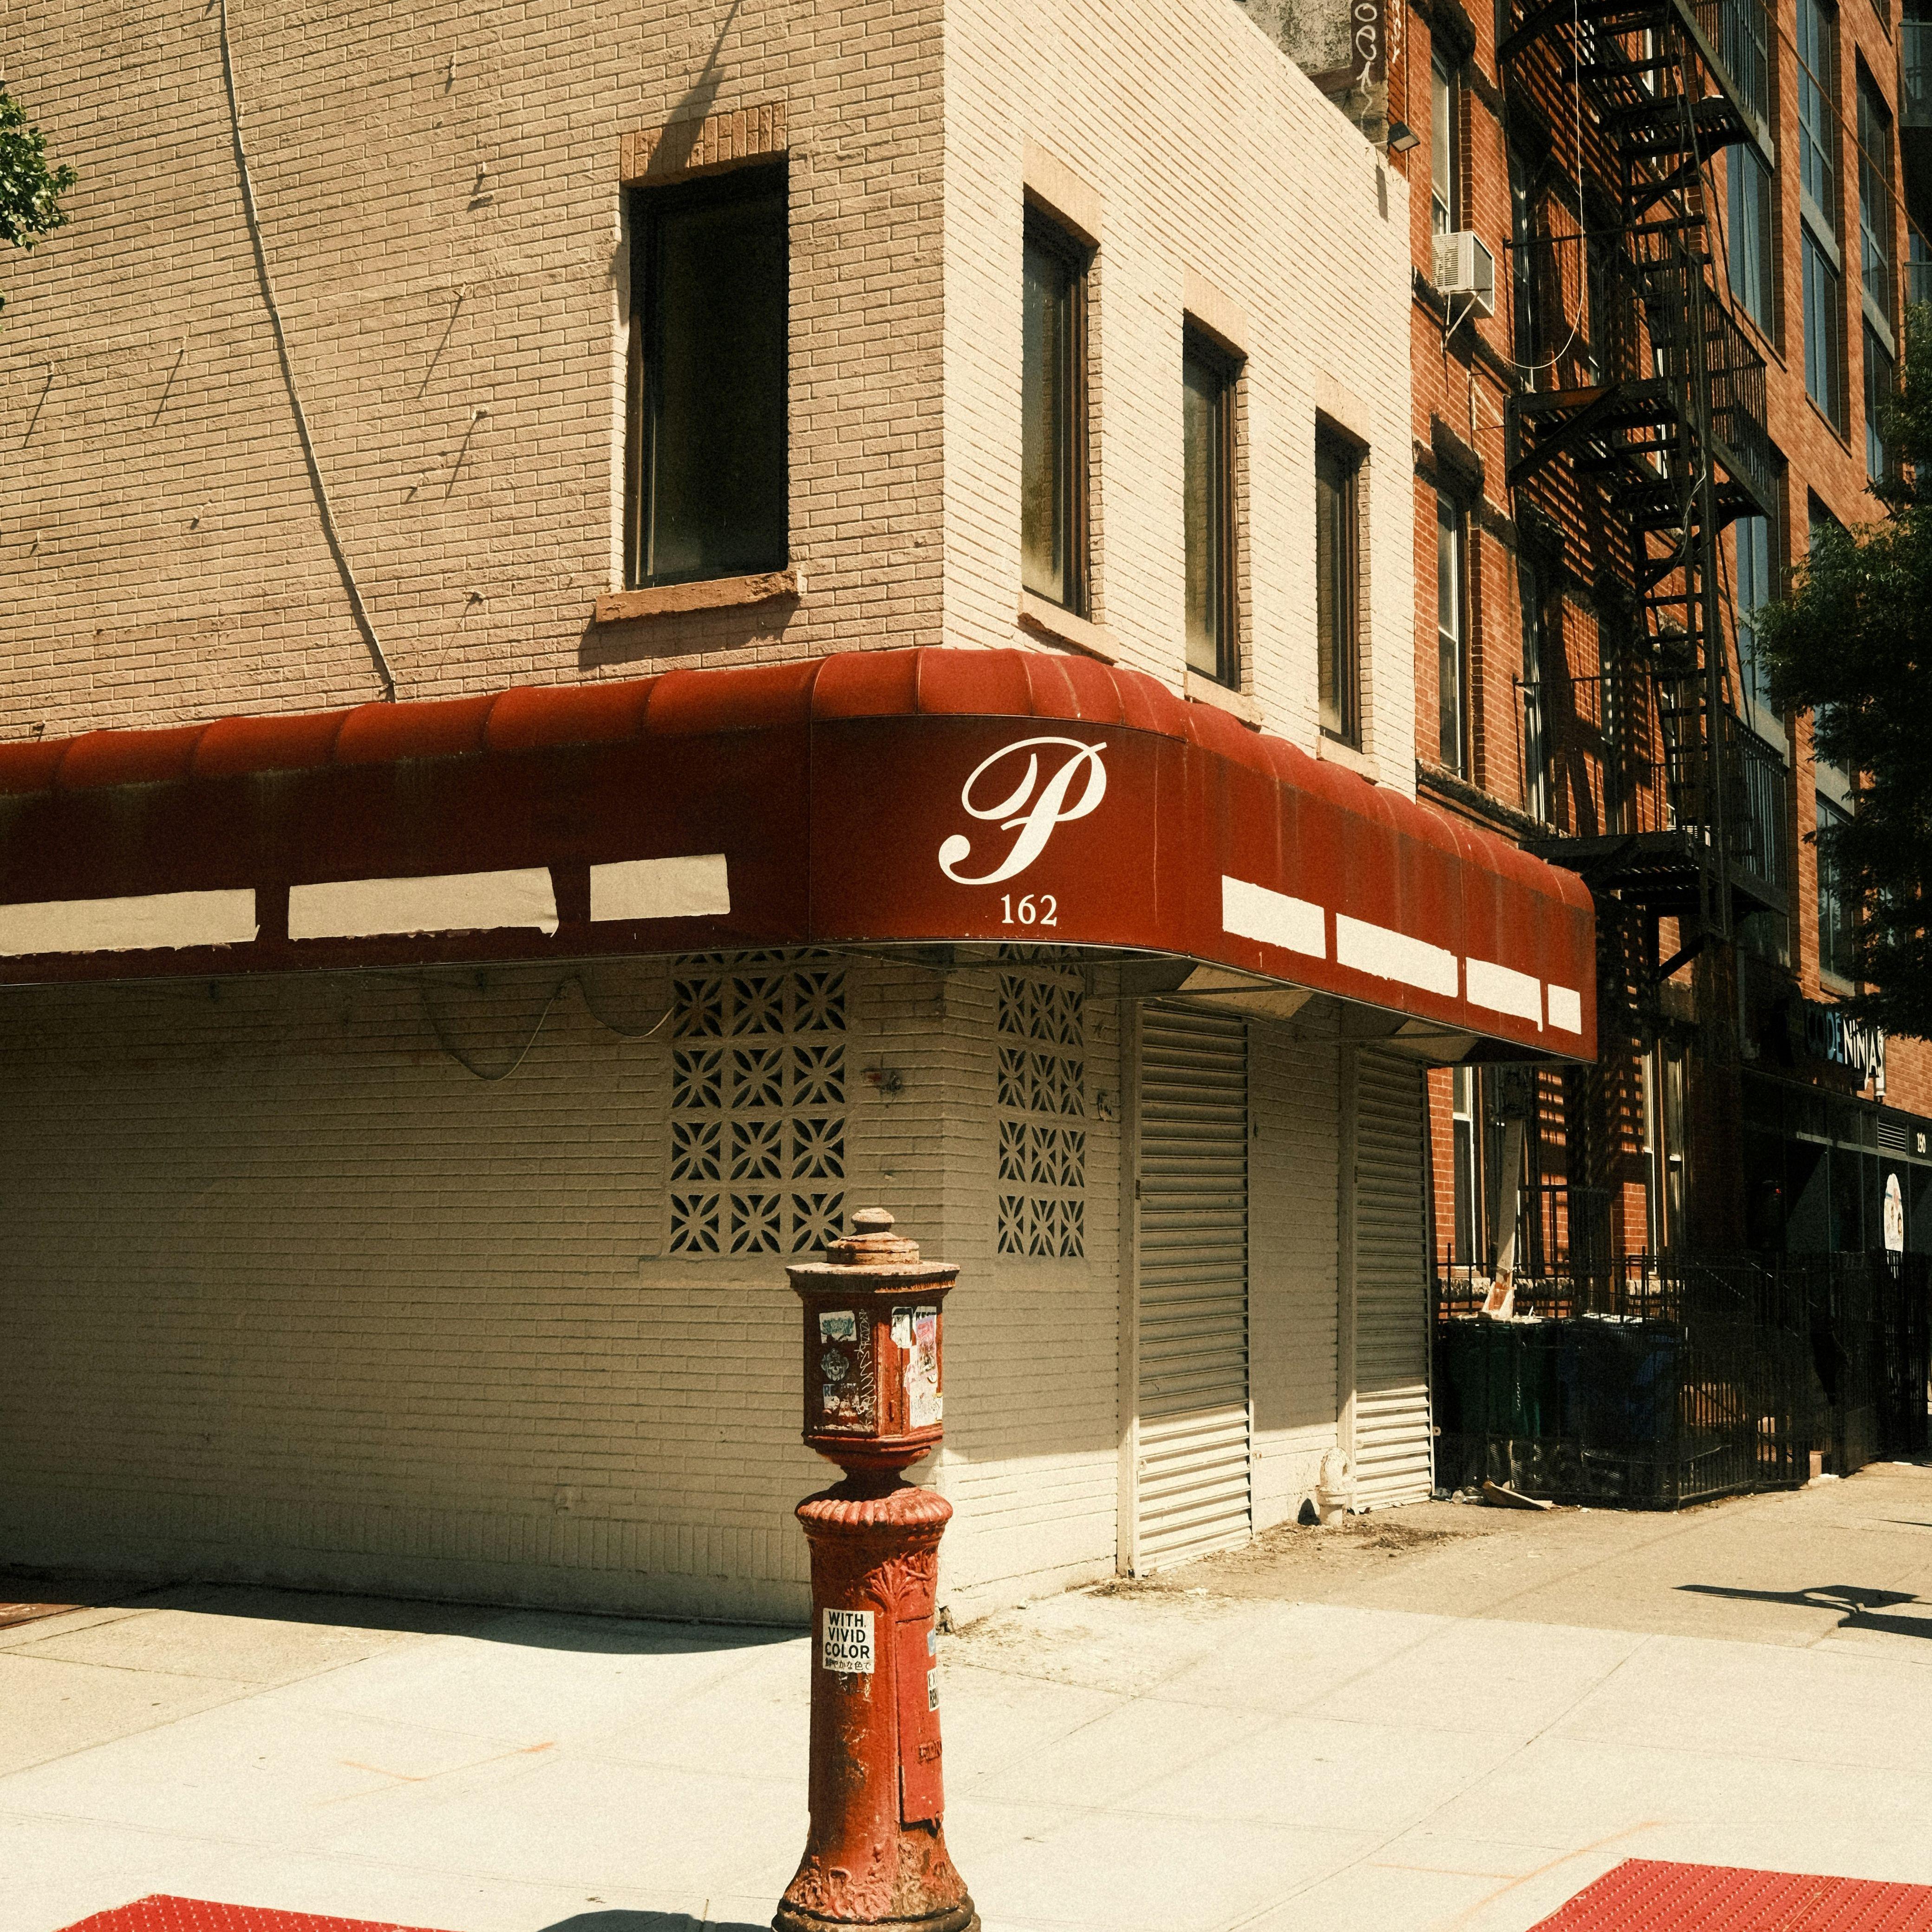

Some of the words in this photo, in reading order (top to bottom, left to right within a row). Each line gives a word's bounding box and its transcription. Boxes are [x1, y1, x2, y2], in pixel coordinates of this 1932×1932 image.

[938, 737, 1107, 885] P
[1001, 894, 1057, 927] 162
[1843, 1018, 1884, 1090] NINJAS
[825, 1642, 870, 1658] COLOR
[828, 1626, 866, 1643] VIVID
